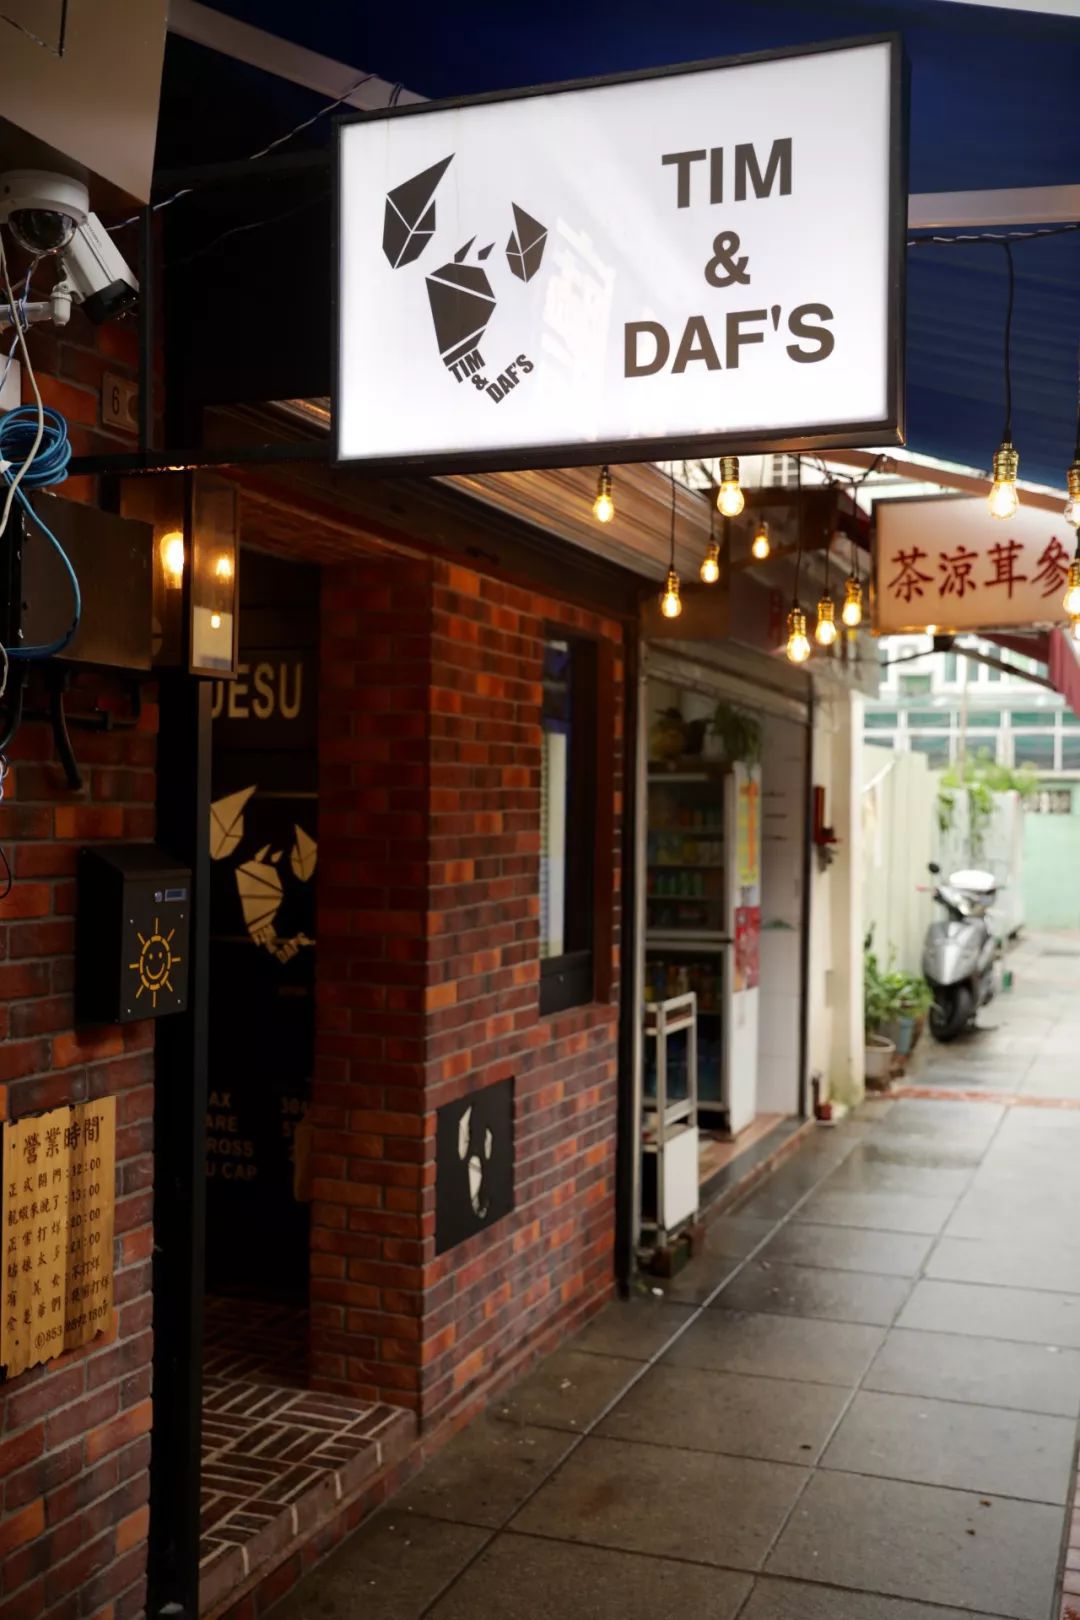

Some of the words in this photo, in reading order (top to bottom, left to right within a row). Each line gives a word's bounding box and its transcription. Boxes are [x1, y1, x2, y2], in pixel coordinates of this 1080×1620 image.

[662, 136, 793, 209] TIM
[704, 230, 751, 289] &
[448, 348, 486, 383] TIM
[623, 303, 836, 379] DAF'S
[471, 374, 490, 391] &
[485, 353, 534, 404] DAF'S
[23, 1115, 99, 1165] 營業時間
